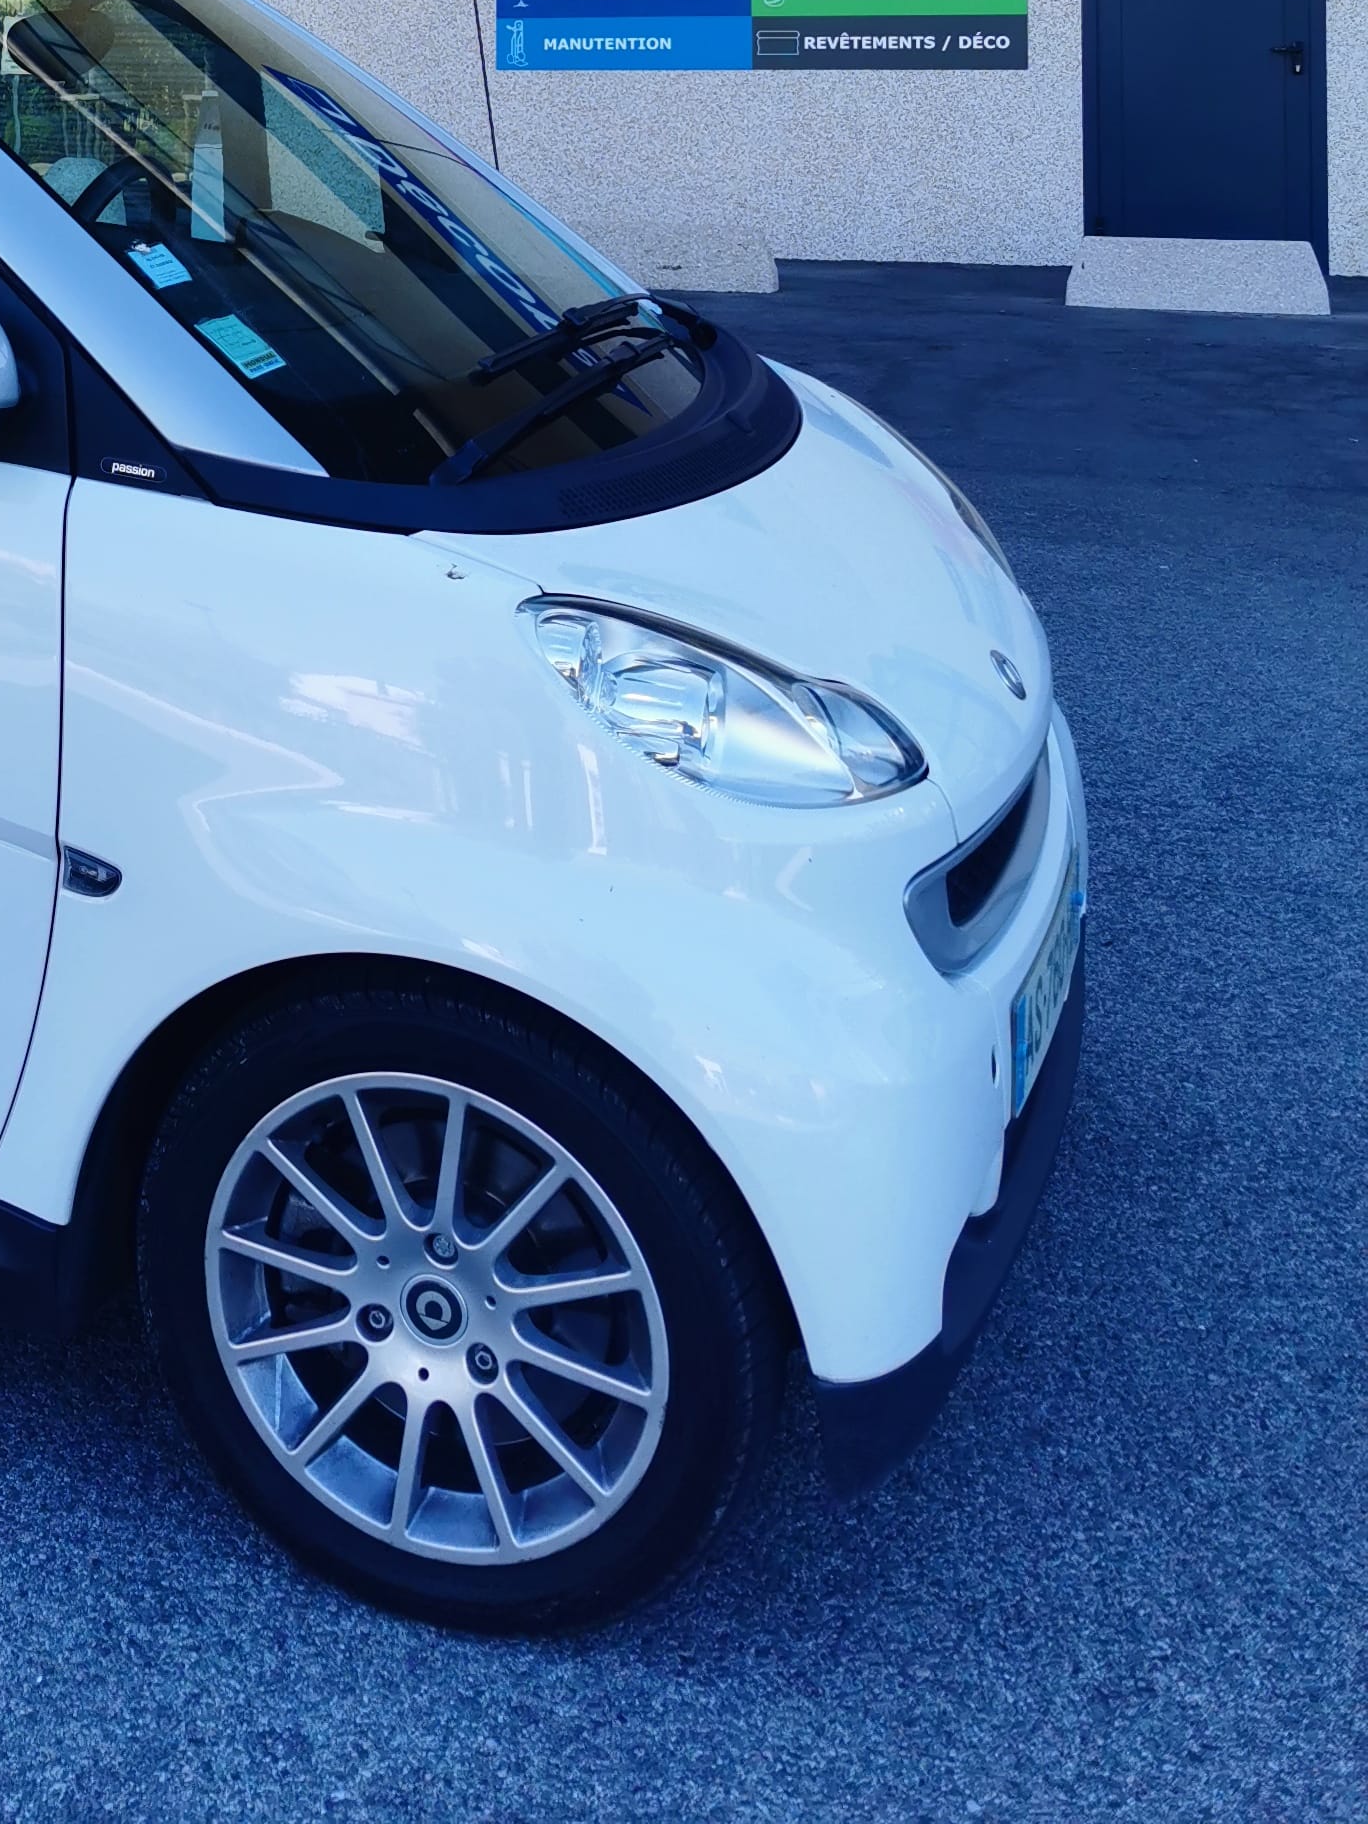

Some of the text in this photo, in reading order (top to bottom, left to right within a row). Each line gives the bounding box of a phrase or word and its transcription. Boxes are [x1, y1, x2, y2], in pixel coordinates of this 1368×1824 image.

[544, 37, 672, 51] MANUTENTION
[804, 32, 935, 50] REVÊTEMENTS
[959, 32, 1010, 50] DÉCO
[112, 462, 155, 478] passion
